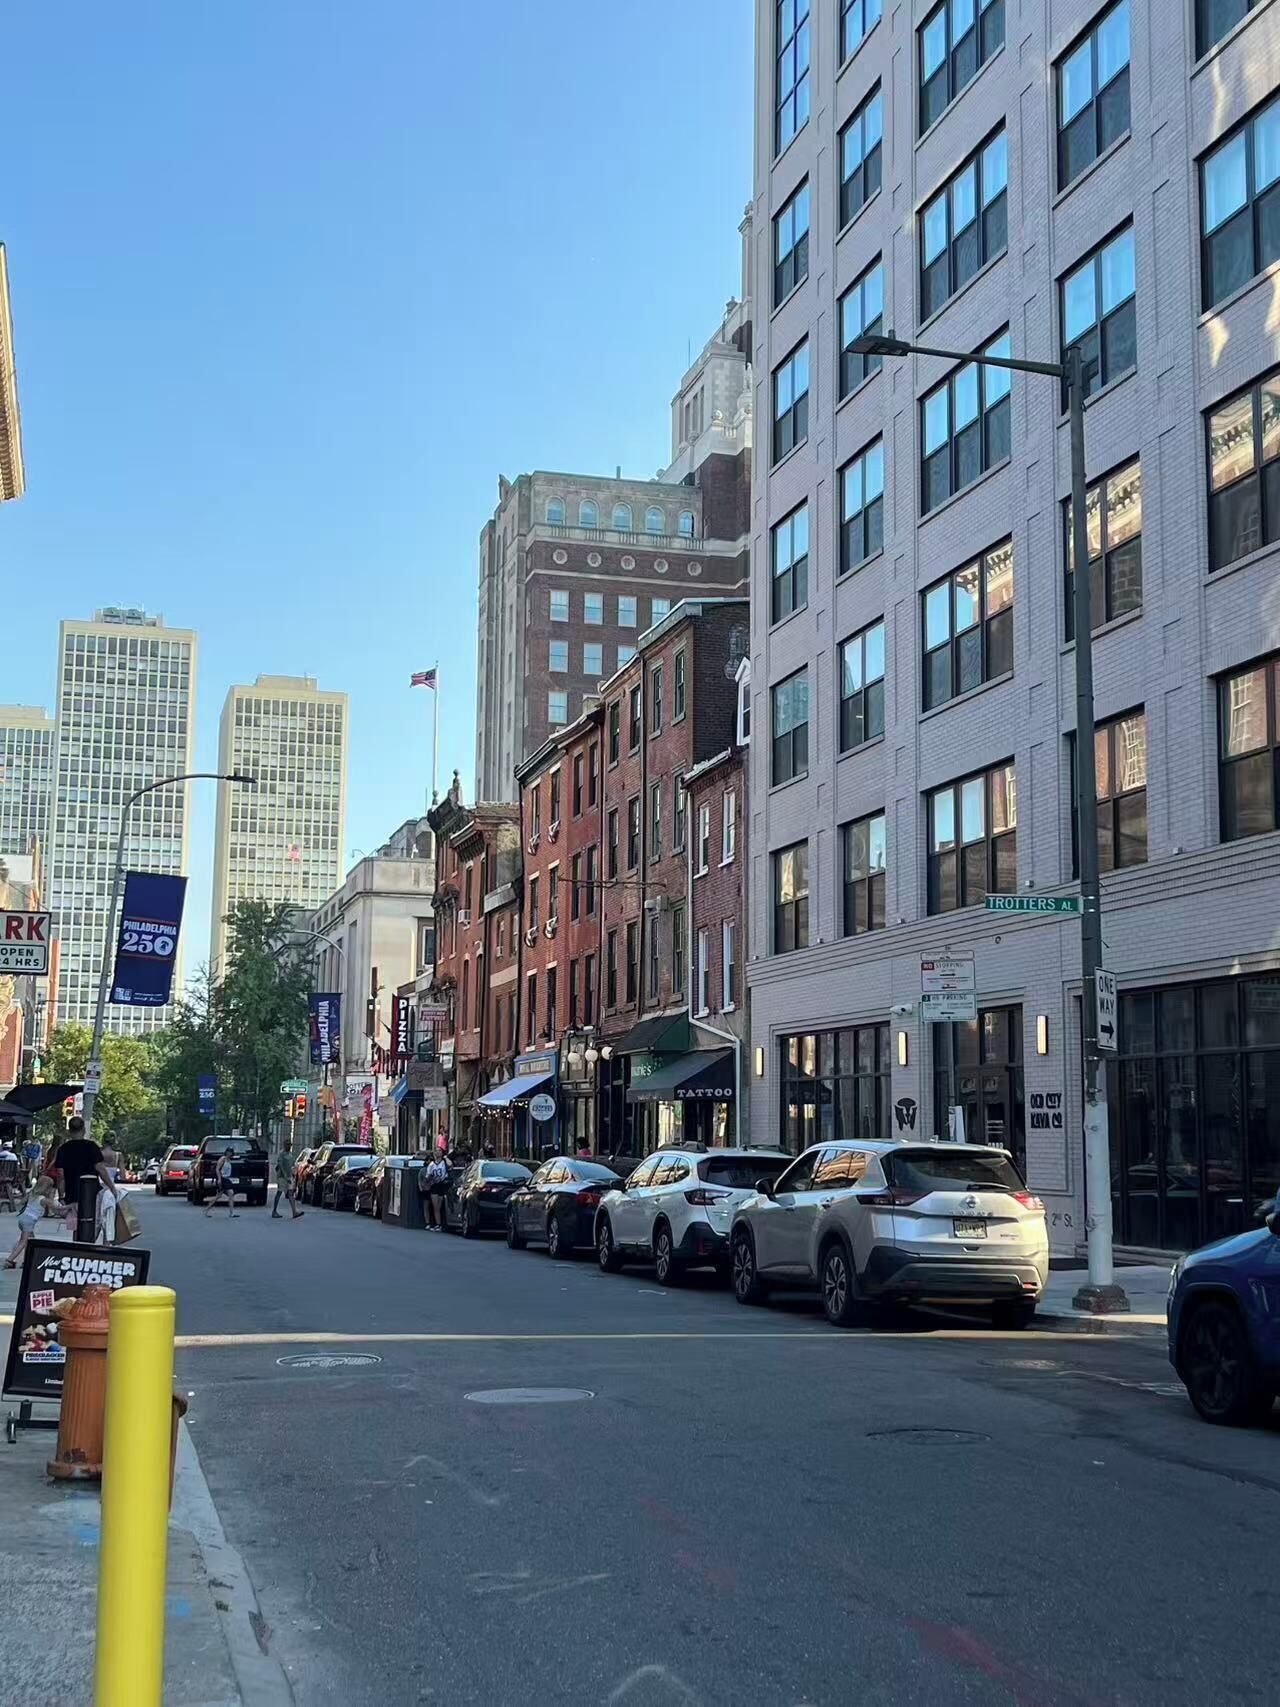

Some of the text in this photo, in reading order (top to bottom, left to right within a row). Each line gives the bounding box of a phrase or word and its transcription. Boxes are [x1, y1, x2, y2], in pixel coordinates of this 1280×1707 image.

[988, 896, 1073, 911] TROTTERS AL
[0, 915, 47, 941] RK
[123, 920, 177, 936] PHILADELPHIA
[0, 947, 34, 957] OPEN
[121, 932, 174, 956] 250
[0, 957, 40, 967] 4 HRS
[1099, 976, 1114, 995] ONE
[1100, 999, 1115, 1016] WAY
[317, 1000, 331, 1062] PHILADELPHIA
[397, 999, 408, 1052] PIZZA
[677, 1088, 733, 1098] TATTOO
[1045, 1092, 1062, 1109] CITY
[1030, 1112, 1050, 1129] KAVA
[60, 1257, 136, 1276] SUMMER
[43, 1269, 123, 1289] FLAVORS
[32, 1298, 54, 1309] PIE
